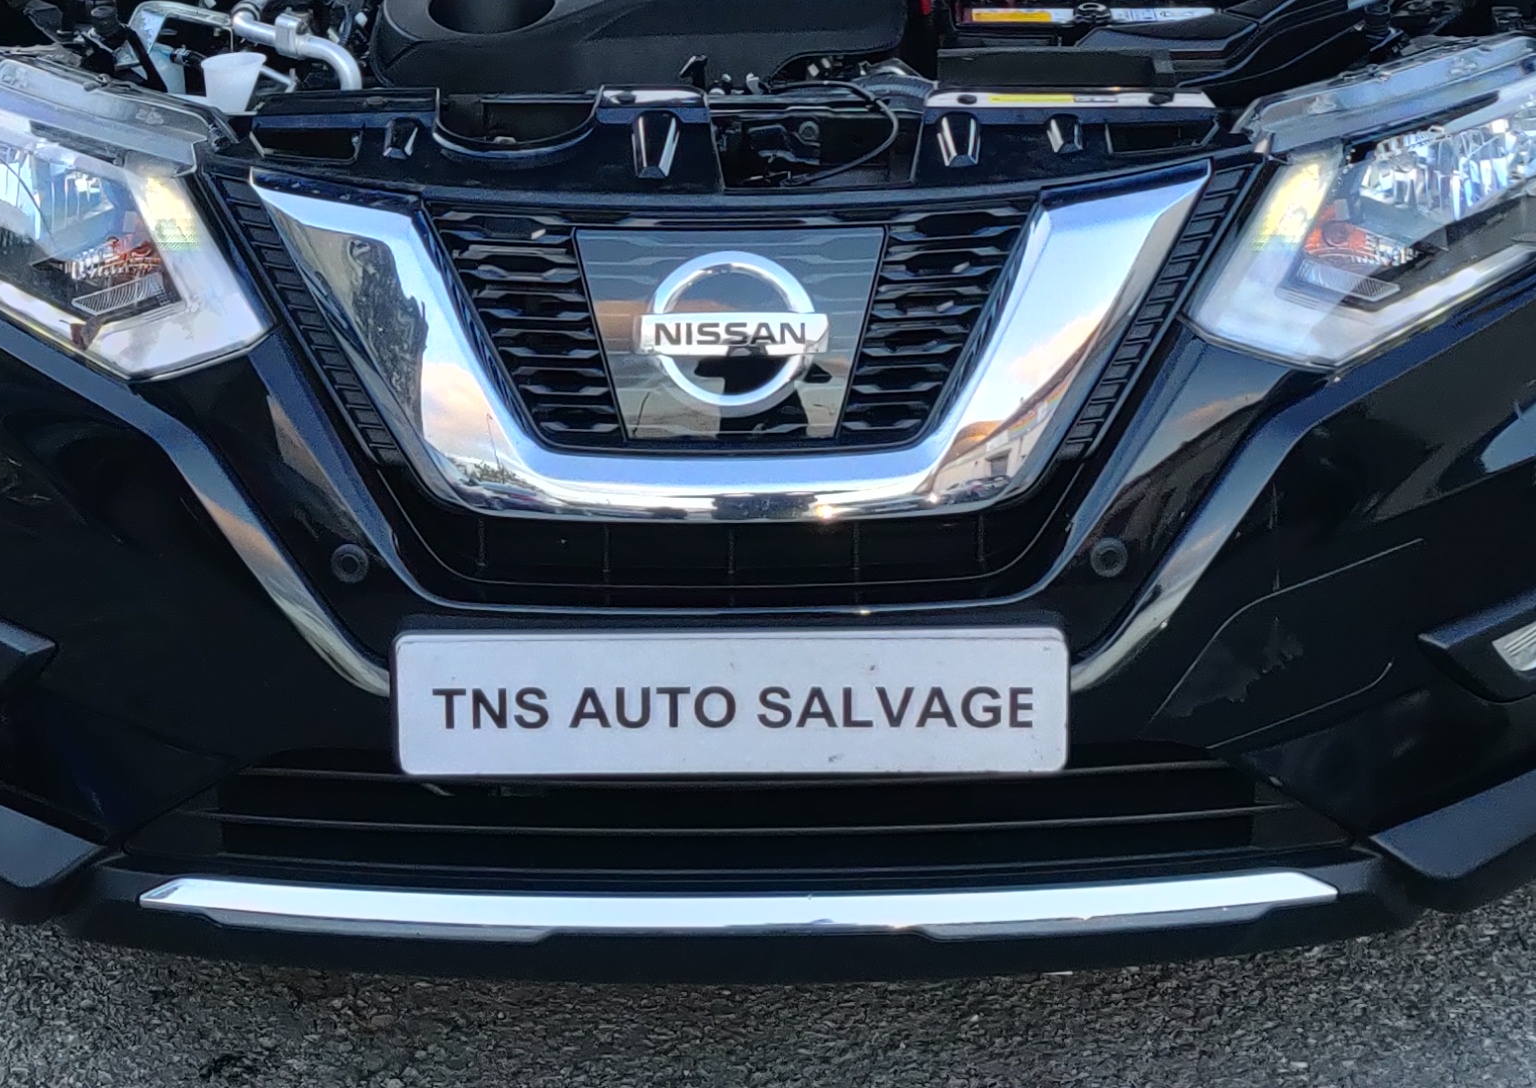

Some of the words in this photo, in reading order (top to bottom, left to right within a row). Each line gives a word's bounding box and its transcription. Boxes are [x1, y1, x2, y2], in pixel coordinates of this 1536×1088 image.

[654, 322, 806, 346] NISSAN
[431, 687, 550, 730] TNS
[569, 686, 738, 729] AUTO
[756, 685, 1035, 729] SALVAGE
